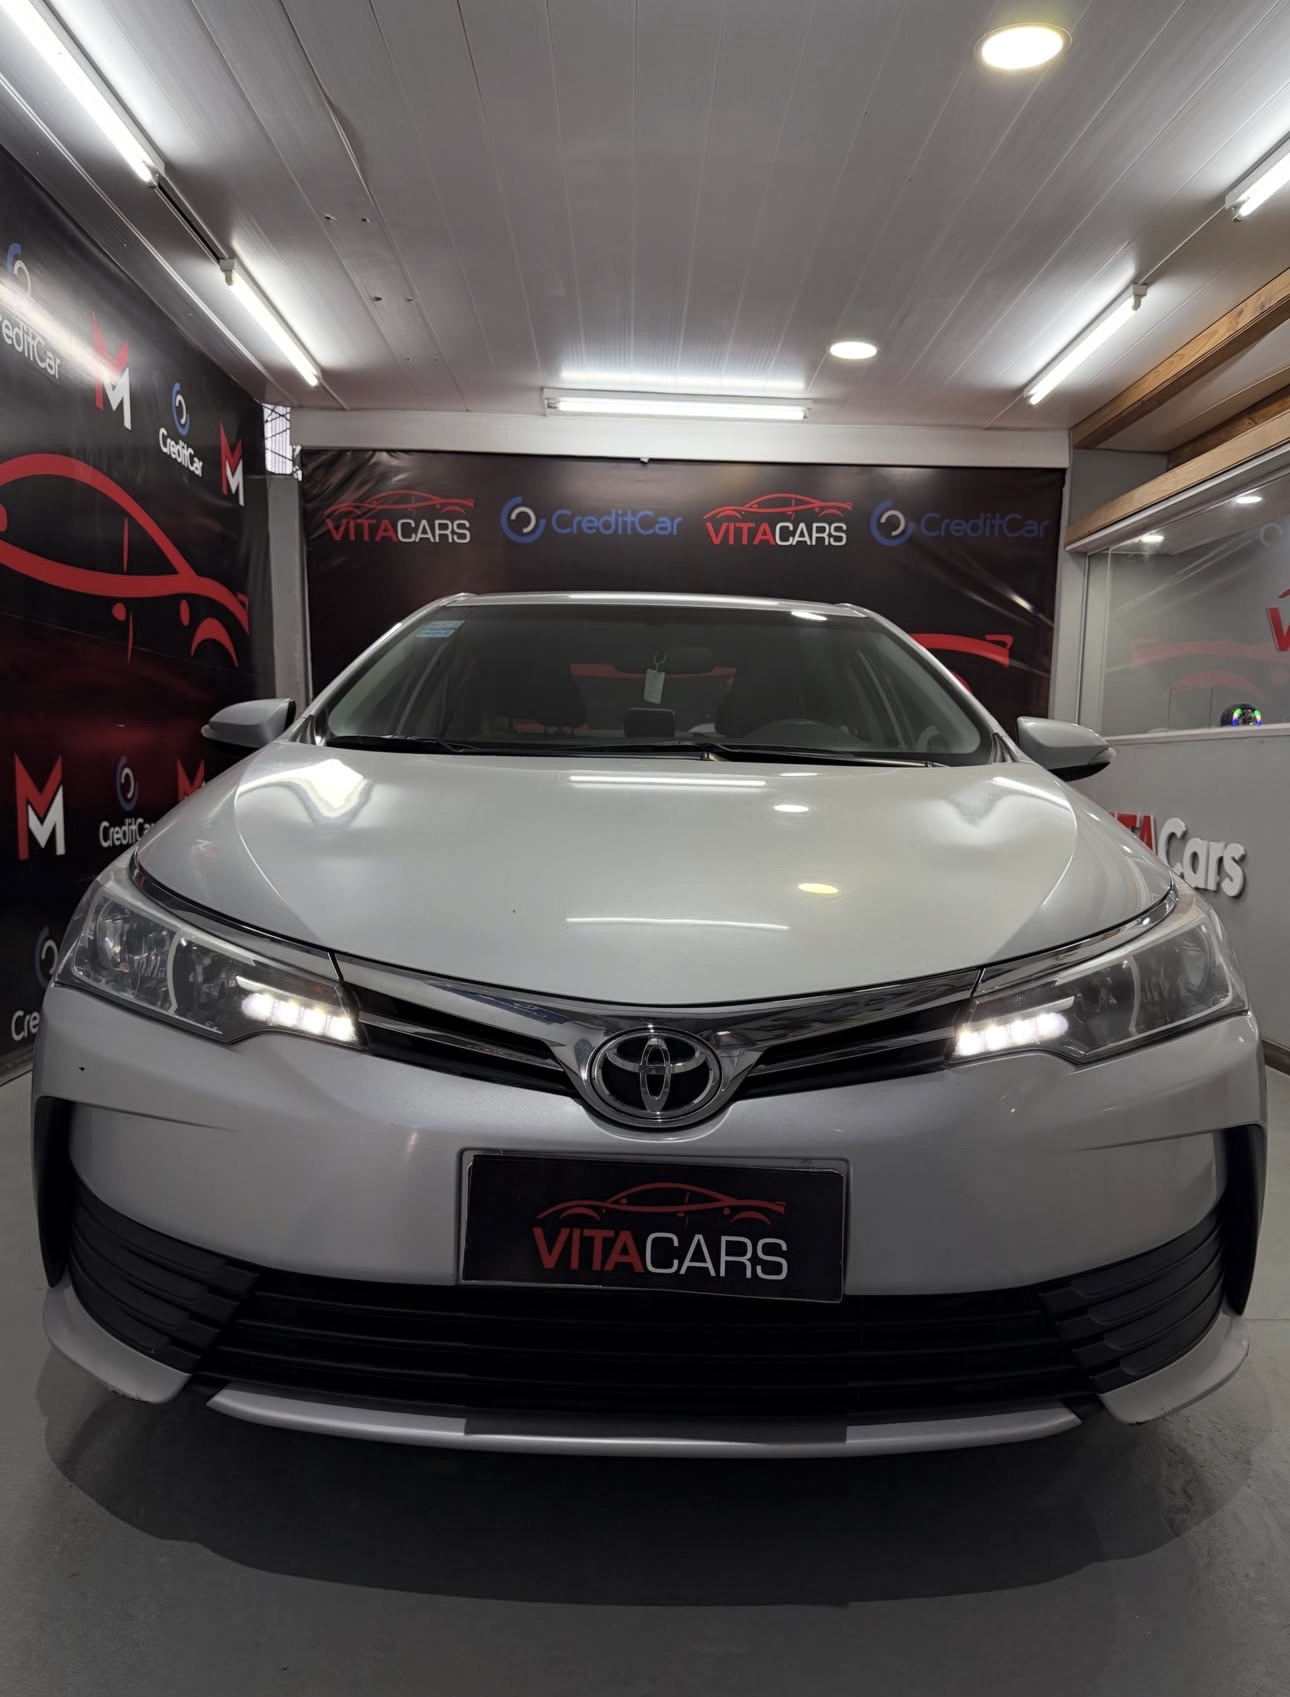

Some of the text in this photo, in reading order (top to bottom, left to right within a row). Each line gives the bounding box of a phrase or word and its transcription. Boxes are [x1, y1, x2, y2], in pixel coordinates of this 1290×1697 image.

[0, 314, 61, 379] editCar
[159, 427, 203, 478] CreditCar
[325, 518, 471, 544] VITACARS
[551, 510, 683, 537] CreditCar
[705, 521, 848, 547] VITACARS
[919, 512, 1049, 538] CreditCar
[99, 817, 156, 848] CreditCa
[11, 1010, 41, 1041] Cre
[532, 1226, 789, 1281] VITACARS
